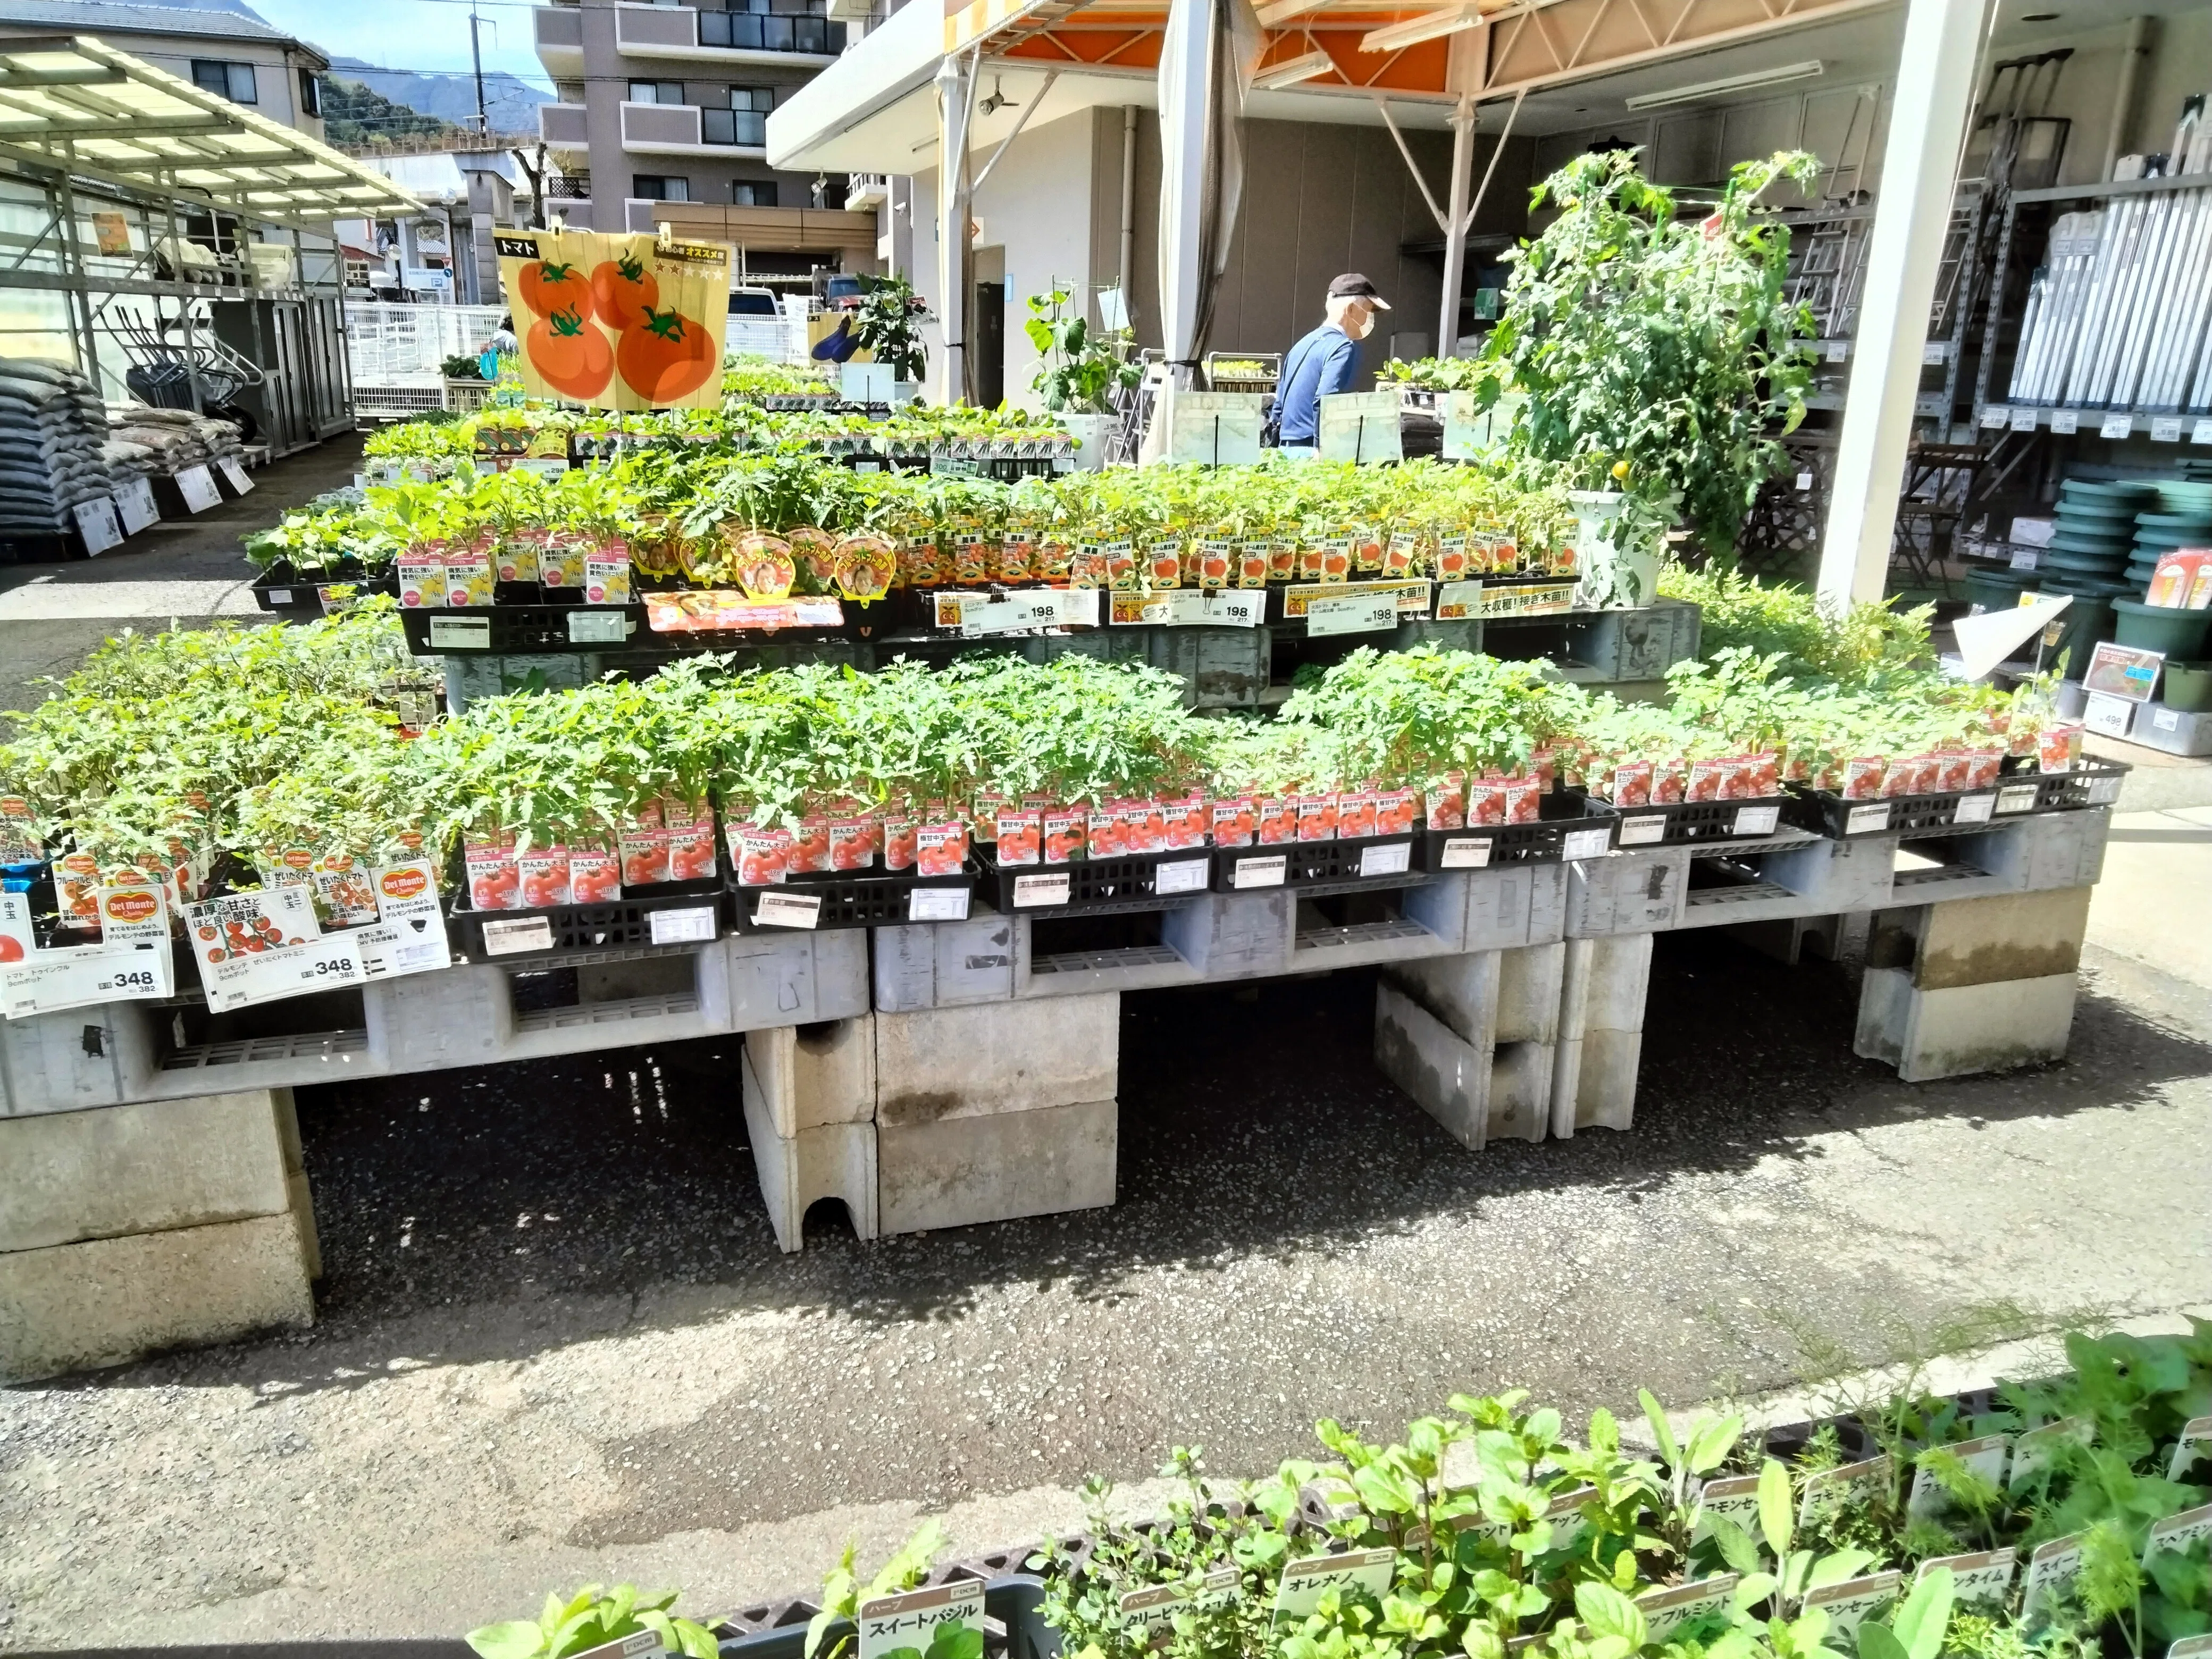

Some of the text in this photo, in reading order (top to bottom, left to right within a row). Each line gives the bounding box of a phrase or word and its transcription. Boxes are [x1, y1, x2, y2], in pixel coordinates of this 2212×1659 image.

[501, 240, 534, 254] トマト
[1481, 598, 1516, 614] 大収穫!
[1519, 590, 1569, 606] 接ぎ木苗!!
[1032, 606, 1054, 617] 198
[1227, 606, 1248, 617] 198
[1373, 609, 1392, 621] 198
[2106, 715, 2122, 726] 498
[1048, 820, 1071, 828] 極甘中玉
[669, 834, 710, 845] かんたん大玉
[746, 839, 787, 849] かんたん大玉
[471, 861, 515, 871] かんたん大玉
[522, 859, 566, 868] かんたん大玉
[573, 859, 616, 868] かんたん大玉
[274, 872, 314, 881] ぜいたくトマ
[320, 873, 364, 884] ぜいたくトマト
[384, 876, 425, 890] Del Monte
[109, 900, 155, 911] Del Monte
[283, 894, 296, 910] 中玉
[292, 891, 303, 906] ミニ
[4, 900, 17, 920] 中玉
[190, 898, 262, 918] 濃厚な甘さと
[385, 904, 436, 918] デルモンテの野菜苗
[193, 907, 264, 928] ほど良い酸味。
[108, 931, 165, 941] デルモンテの野菜苗
[217, 950, 306, 975] デルモンテ ぜいたくトマトミニ
[315, 958, 353, 975] 348
[31, 965, 70, 975] トゥインクル
[219, 969, 250, 981] 9cmポット
[7, 976, 43, 987] 9cmポット
[114, 971, 154, 987] 348
[1705, 1497, 1758, 1513] コモンセ
[1291, 1561, 1324, 1572] ハーブ
[1289, 1571, 1353, 1591] オレガノ
[1953, 1569, 2004, 1587] ンタイム
[869, 1597, 903, 1613] ハーブ
[1128, 1590, 1161, 1606] ハーブ
[1824, 1591, 1890, 1616] モンセージ
[1648, 1595, 1730, 1629] ップルミント
[869, 1604, 978, 1638] スイートバジル
